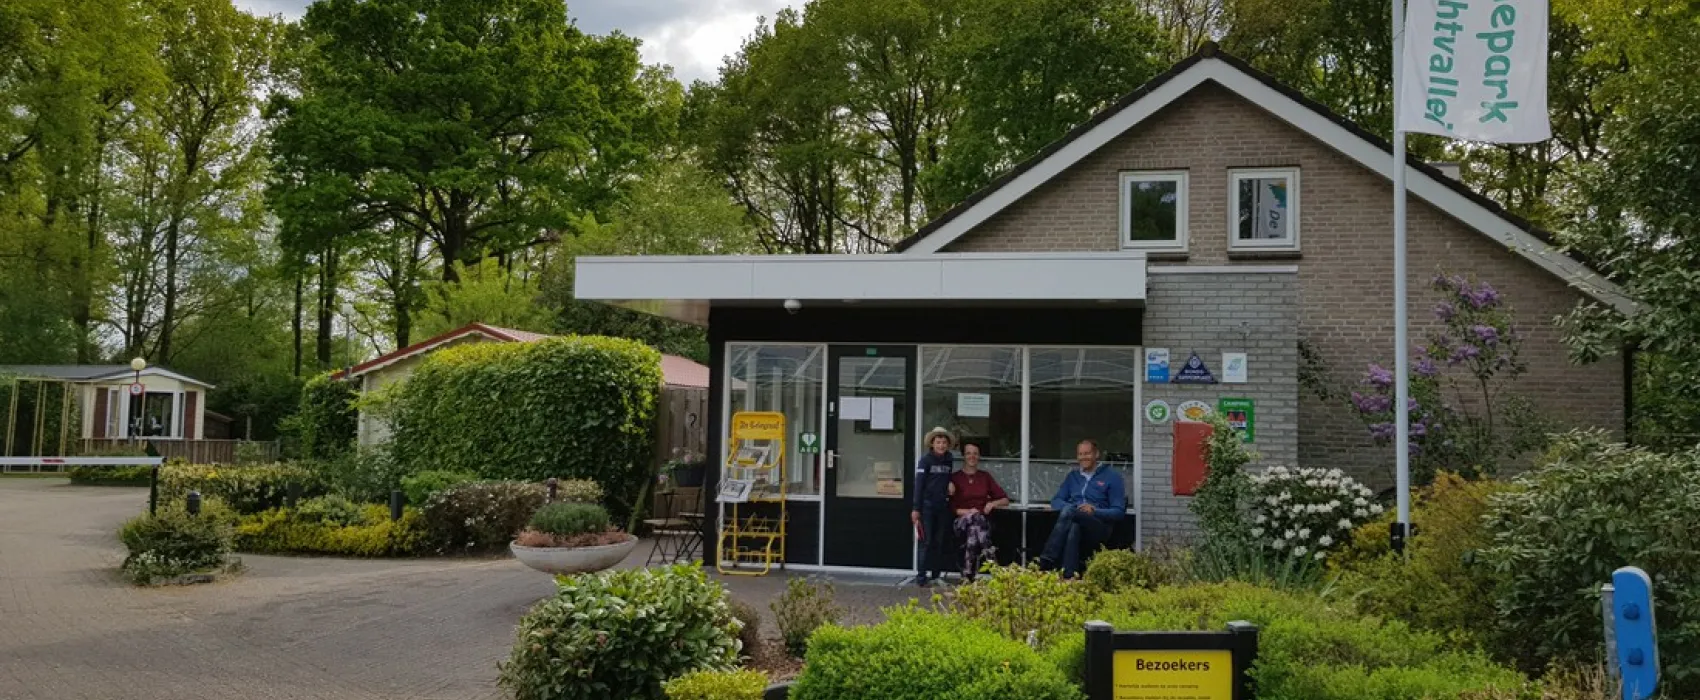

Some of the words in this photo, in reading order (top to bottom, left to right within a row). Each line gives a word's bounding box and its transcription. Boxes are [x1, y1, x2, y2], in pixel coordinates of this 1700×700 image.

[1424, 0, 1468, 131] htvallei
[1476, 0, 1518, 123] epark
[1136, 658, 1210, 671] Bezoekers
